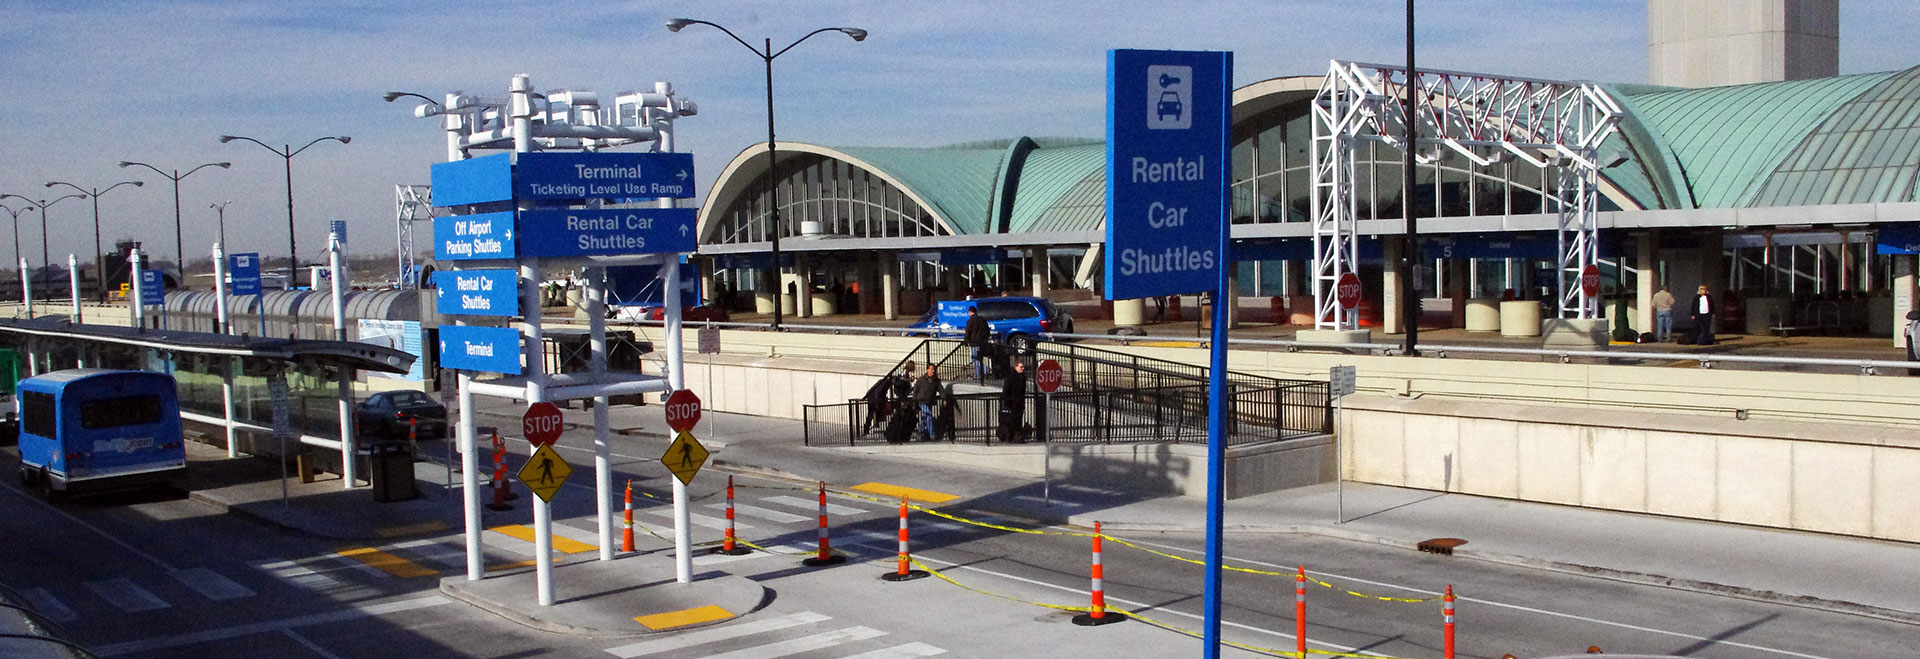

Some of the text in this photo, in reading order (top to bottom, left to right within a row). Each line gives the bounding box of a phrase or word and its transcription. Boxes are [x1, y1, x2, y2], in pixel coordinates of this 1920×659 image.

[574, 163, 641, 179] Terminal
[1132, 155, 1205, 183] Rental
[530, 182, 683, 196] Ticketing Level Use Ramp
[567, 214, 654, 231] Rental Car
[1148, 201, 1188, 229] Car
[455, 220, 492, 237] Off Airport
[446, 236, 502, 257] Parking Shuttles
[578, 234, 645, 250] Shuttles
[1443, 246, 1453, 258] 5
[1120, 245, 1214, 276] Shuttles
[457, 275, 493, 291] Rental Car
[1584, 274, 1600, 288] STOP
[1339, 284, 1360, 299] STOP
[461, 294, 491, 310] Shuttles
[465, 341, 494, 357] Terminal
[1039, 369, 1062, 383] STOP
[667, 402, 700, 421] STOP
[525, 415, 561, 434] STOP
